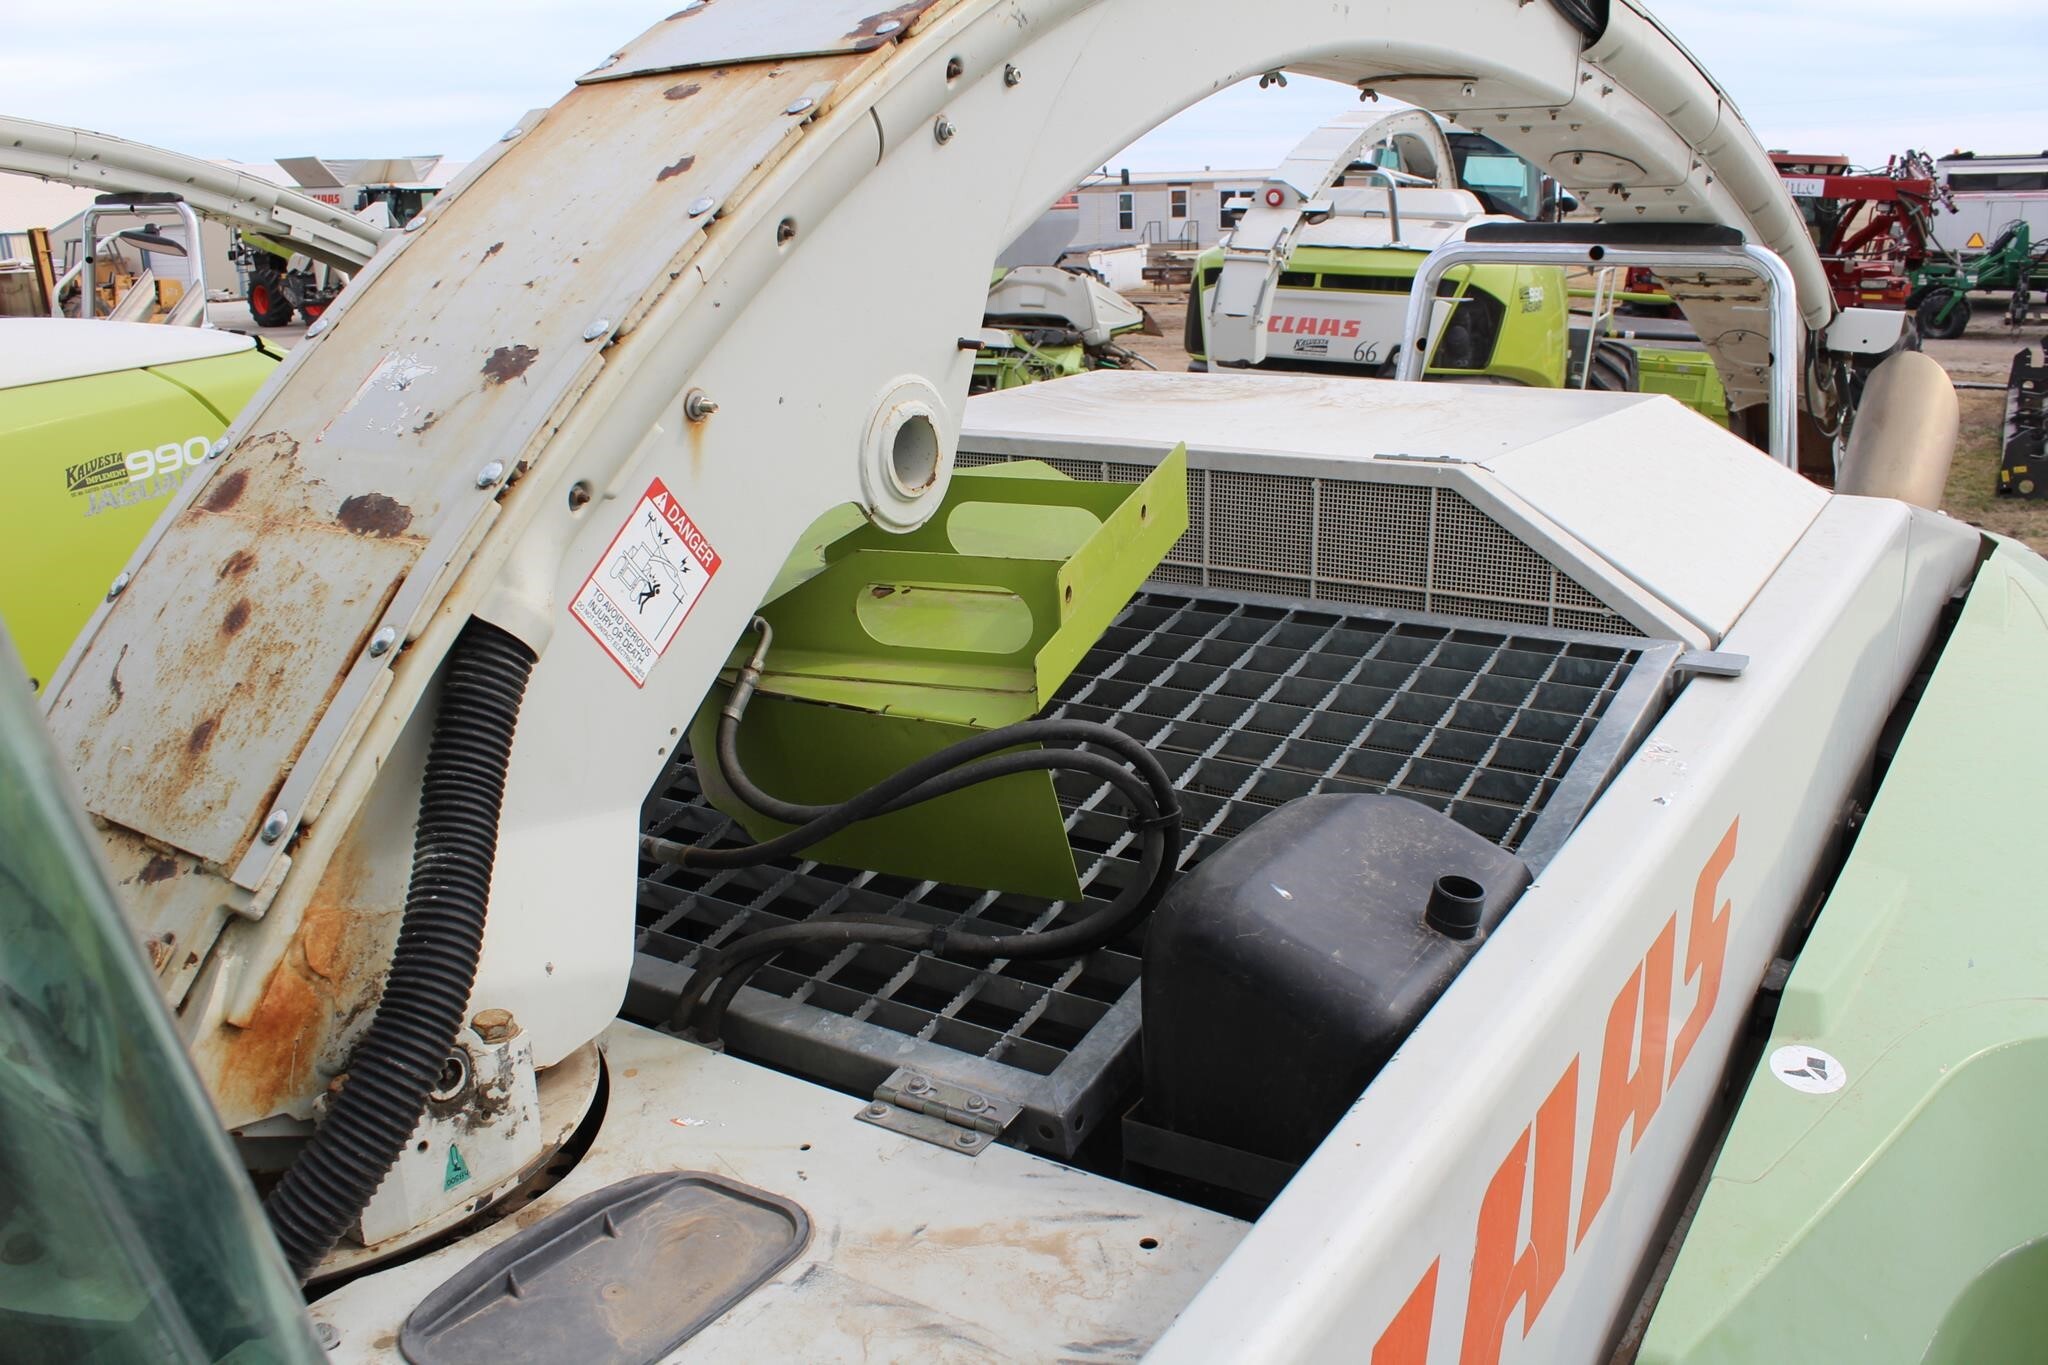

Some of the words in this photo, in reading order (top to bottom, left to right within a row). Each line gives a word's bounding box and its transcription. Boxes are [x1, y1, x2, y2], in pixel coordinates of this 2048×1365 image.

[1267, 315, 1361, 338] CLAAS
[1354, 341, 1379, 362] 66
[65, 452, 124, 488] KALVESTA
[85, 469, 128, 485] IMPLEMENT
[125, 436, 211, 482] 990
[666, 503, 714, 568] DANGER
[587, 599, 614, 628] INJURY
[611, 626, 624, 641] OR
[622, 639, 645, 664] DEATH
[593, 588, 604, 602] TO
[603, 601, 624, 625] AVOID
[622, 622, 652, 657] SERIOUS
